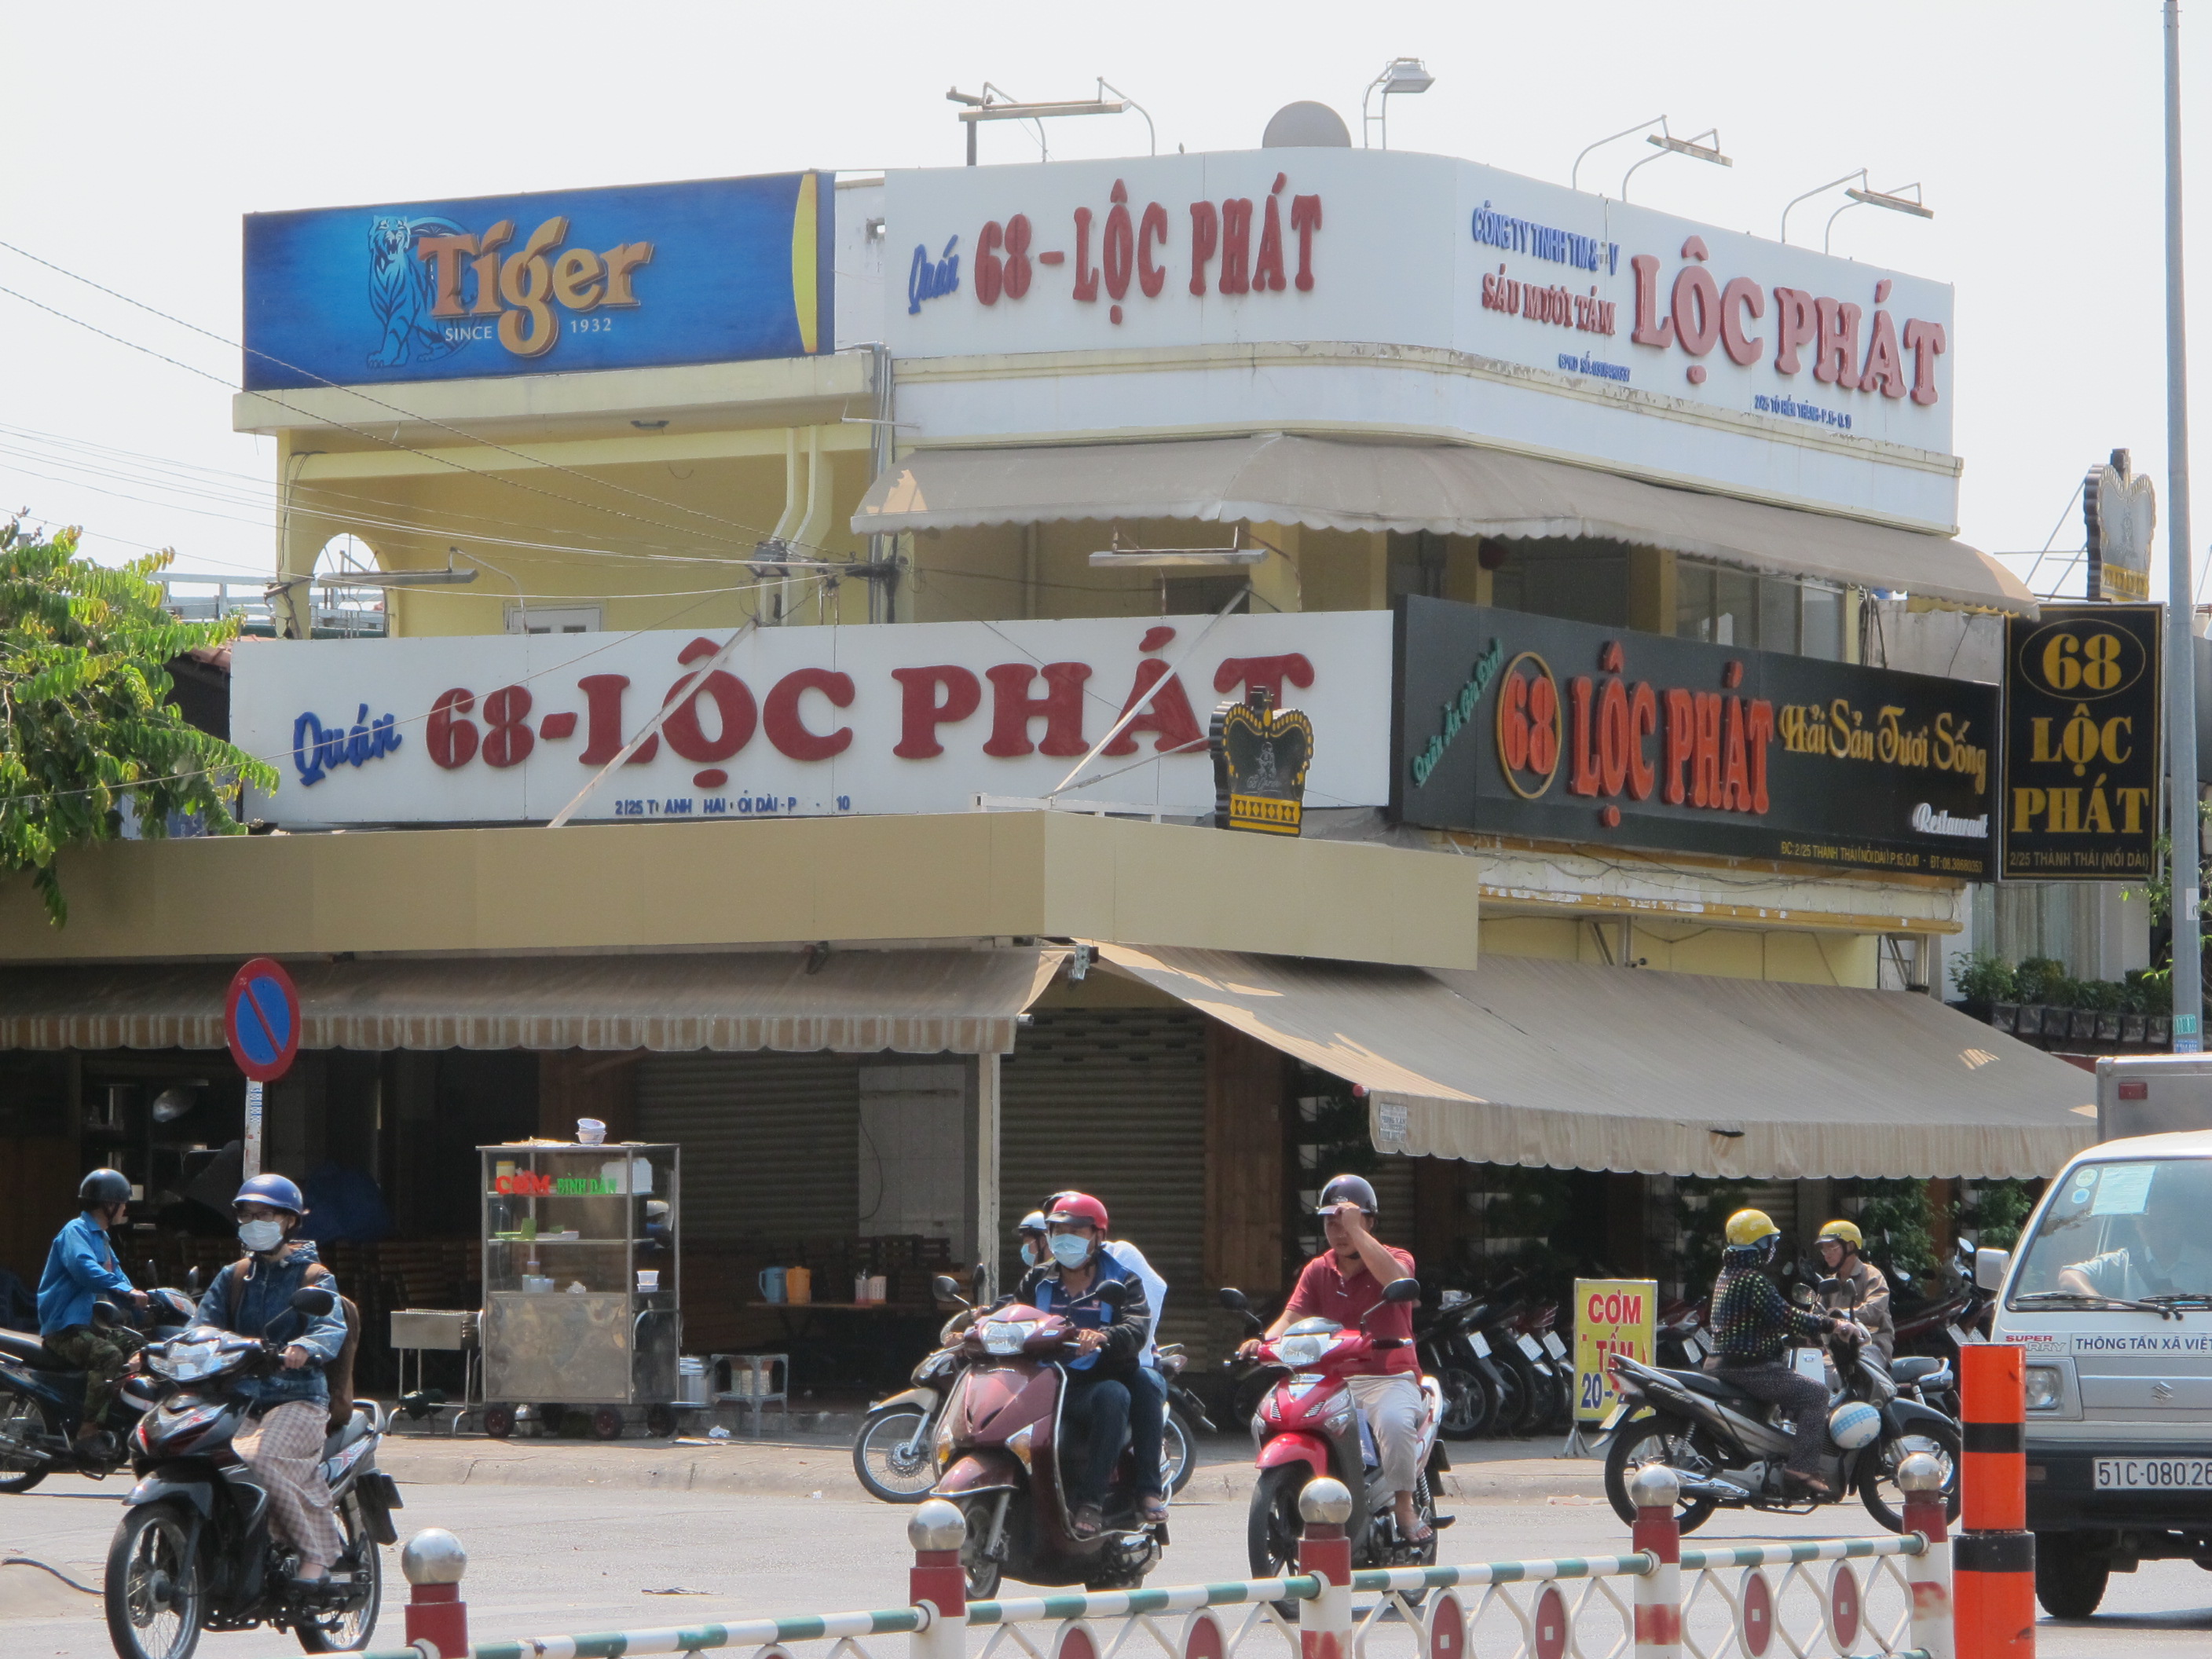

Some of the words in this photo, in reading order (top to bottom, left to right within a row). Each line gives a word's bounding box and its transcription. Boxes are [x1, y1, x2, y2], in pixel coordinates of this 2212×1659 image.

[1189, 171, 1323, 296] PHÁT
[1531, 223, 1567, 265] TNHH
[418, 216, 657, 358] Tiger
[1482, 263, 1522, 315] SÁU
[1575, 285, 1617, 335] TÁM
[445, 325, 493, 342] SINCE
[569, 317, 612, 334] 1932
[1631, 235, 1766, 385] LỘC
[1774, 279, 1946, 406] PHÁT
[2043, 634, 2122, 690] 68
[293, 703, 402, 787] Quán
[891, 625, 1315, 760] PHÁT
[1503, 672, 1557, 775] 68
[1570, 640, 1655, 828] LỘC
[1663, 660, 1774, 814] PHÁT
[1778, 704, 1827, 755] Hải
[1828, 699, 1874, 761] Sản
[1933, 712, 1987, 794] Sống
[2031, 703, 2133, 776] LỘC
[615, 799, 643, 815] 2/25
[837, 795, 851, 811] 10
[1912, 803, 1988, 838] Restaurant
[2012, 773, 2149, 833] PHÁT
[2010, 852, 2031, 866] 2/25
[2034, 848, 2071, 866] THÀNH
[2074, 848, 2099, 866] THÁI
[1588, 1289, 1643, 1324] CƠM
[2076, 1335, 2126, 1350] THÔNG
[2130, 1333, 2157, 1350] TẤN
[2162, 1335, 2181, 1350] XÃ
[1580, 1373, 1603, 1409] 20
